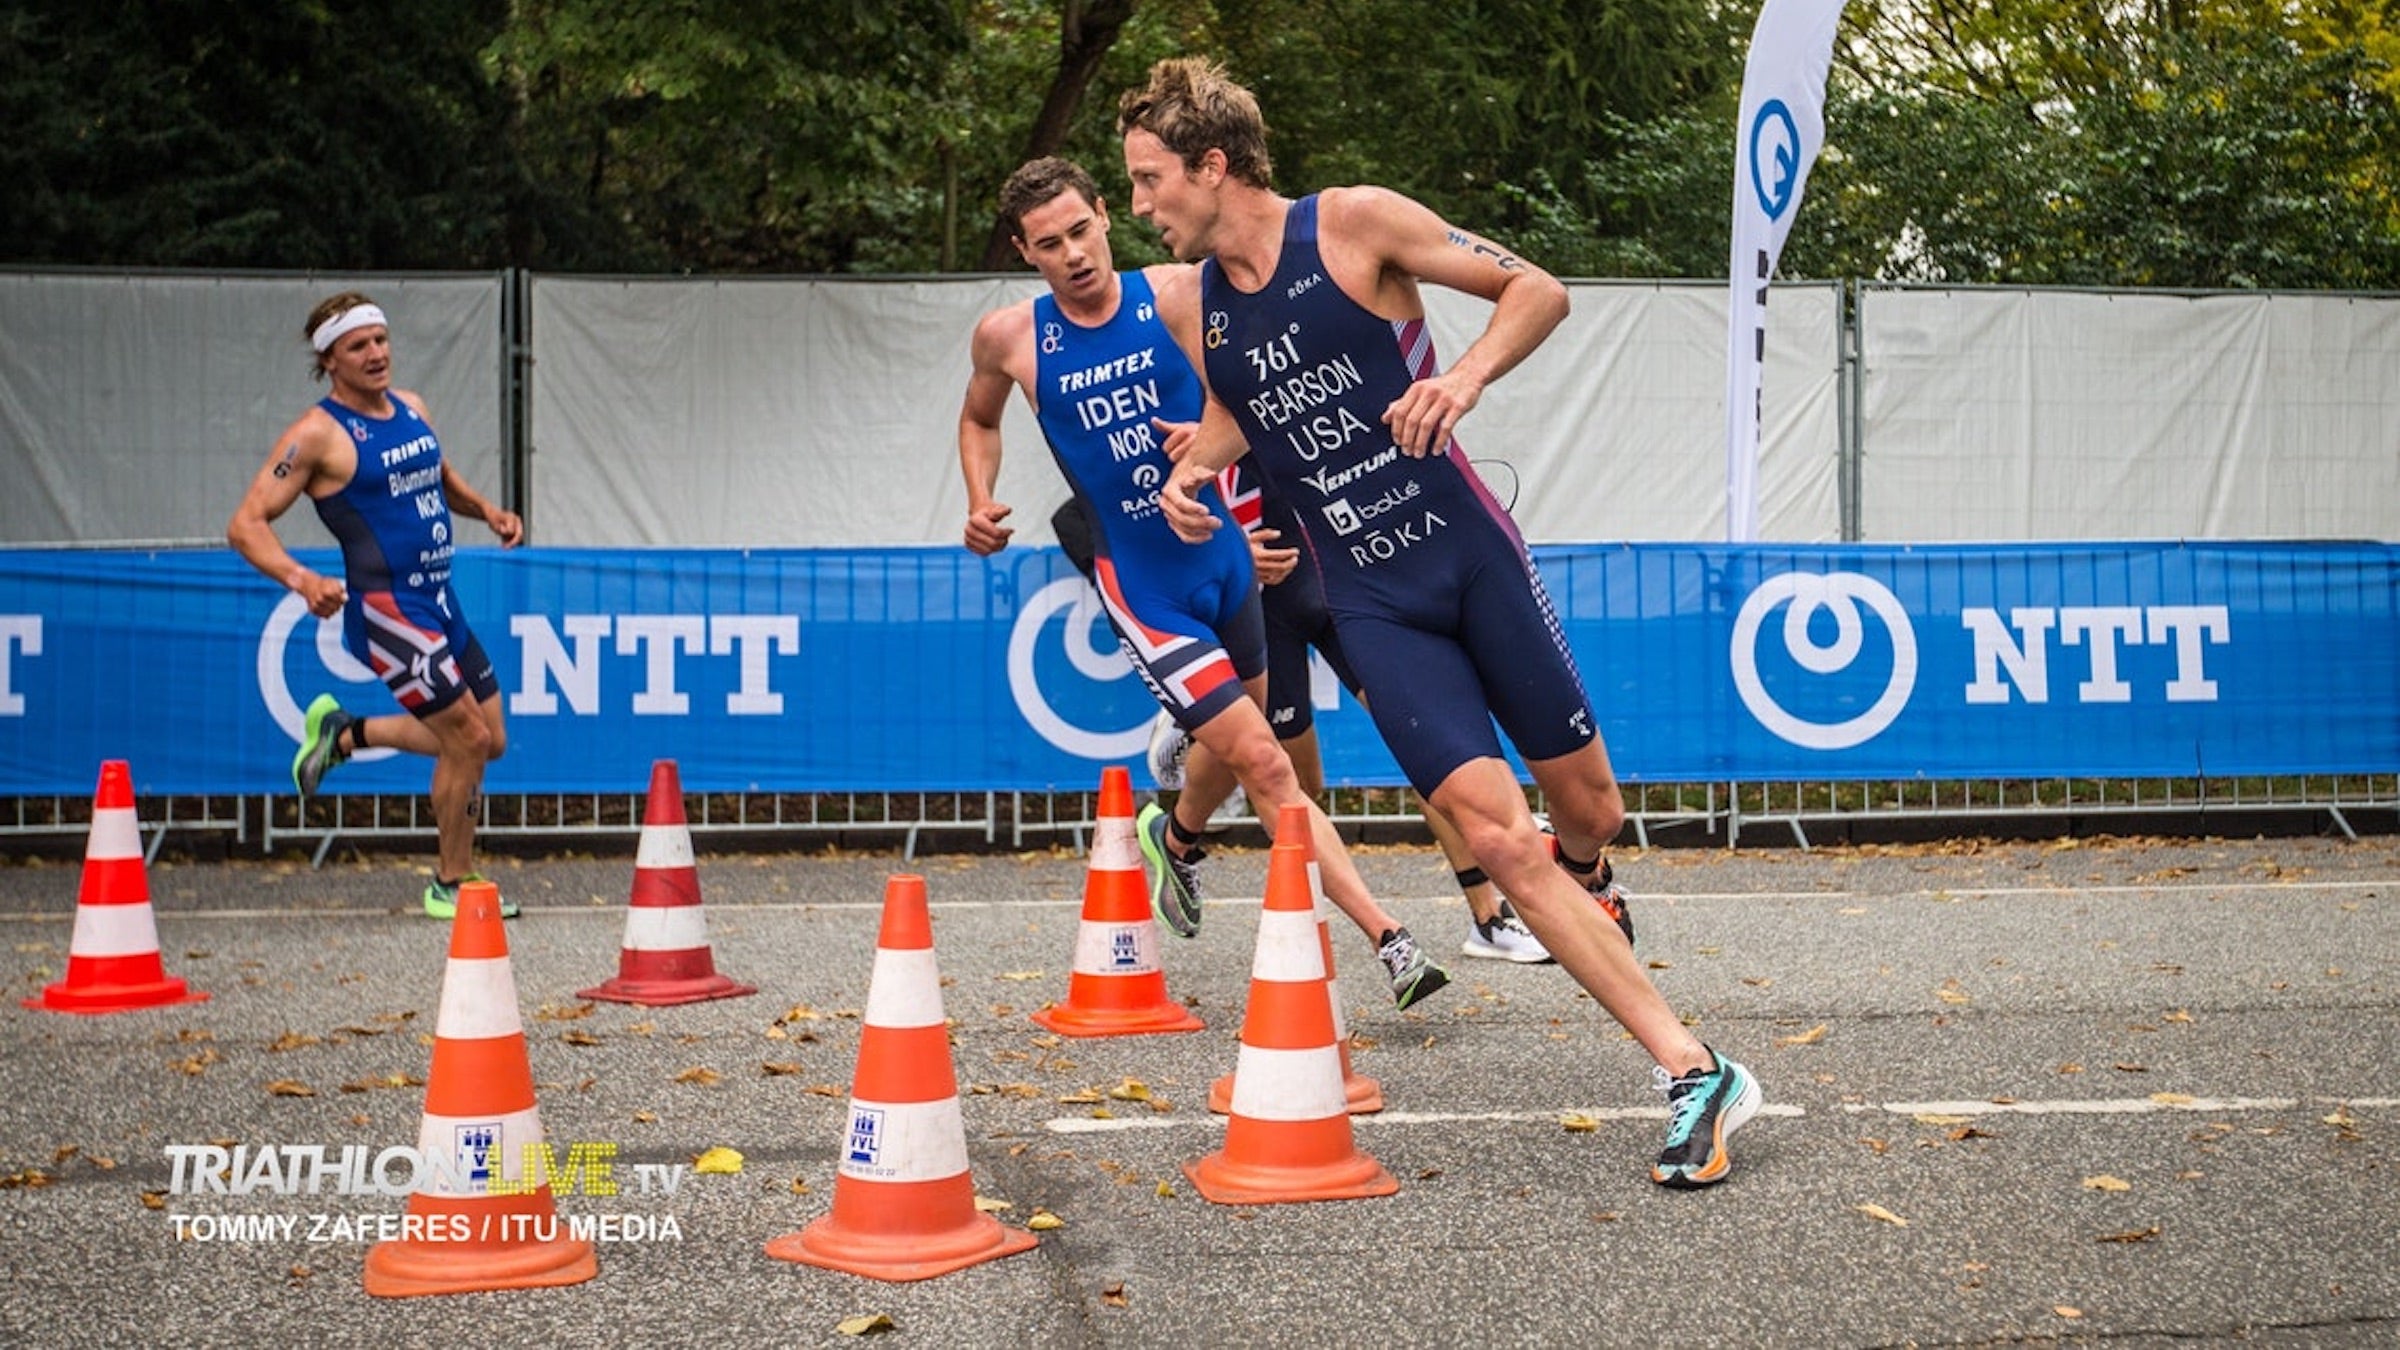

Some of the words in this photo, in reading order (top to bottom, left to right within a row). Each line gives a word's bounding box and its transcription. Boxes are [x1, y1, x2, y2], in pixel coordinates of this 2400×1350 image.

[1060, 346, 1155, 394] TRIMTEX
[1248, 353, 1363, 431] PEARSON
[1076, 379, 1160, 431] IDEN
[1107, 423, 1157, 462] NOR
[1287, 406, 1372, 461] USA
[510, 614, 799, 716] NTT
[1961, 606, 2230, 704] NTT
